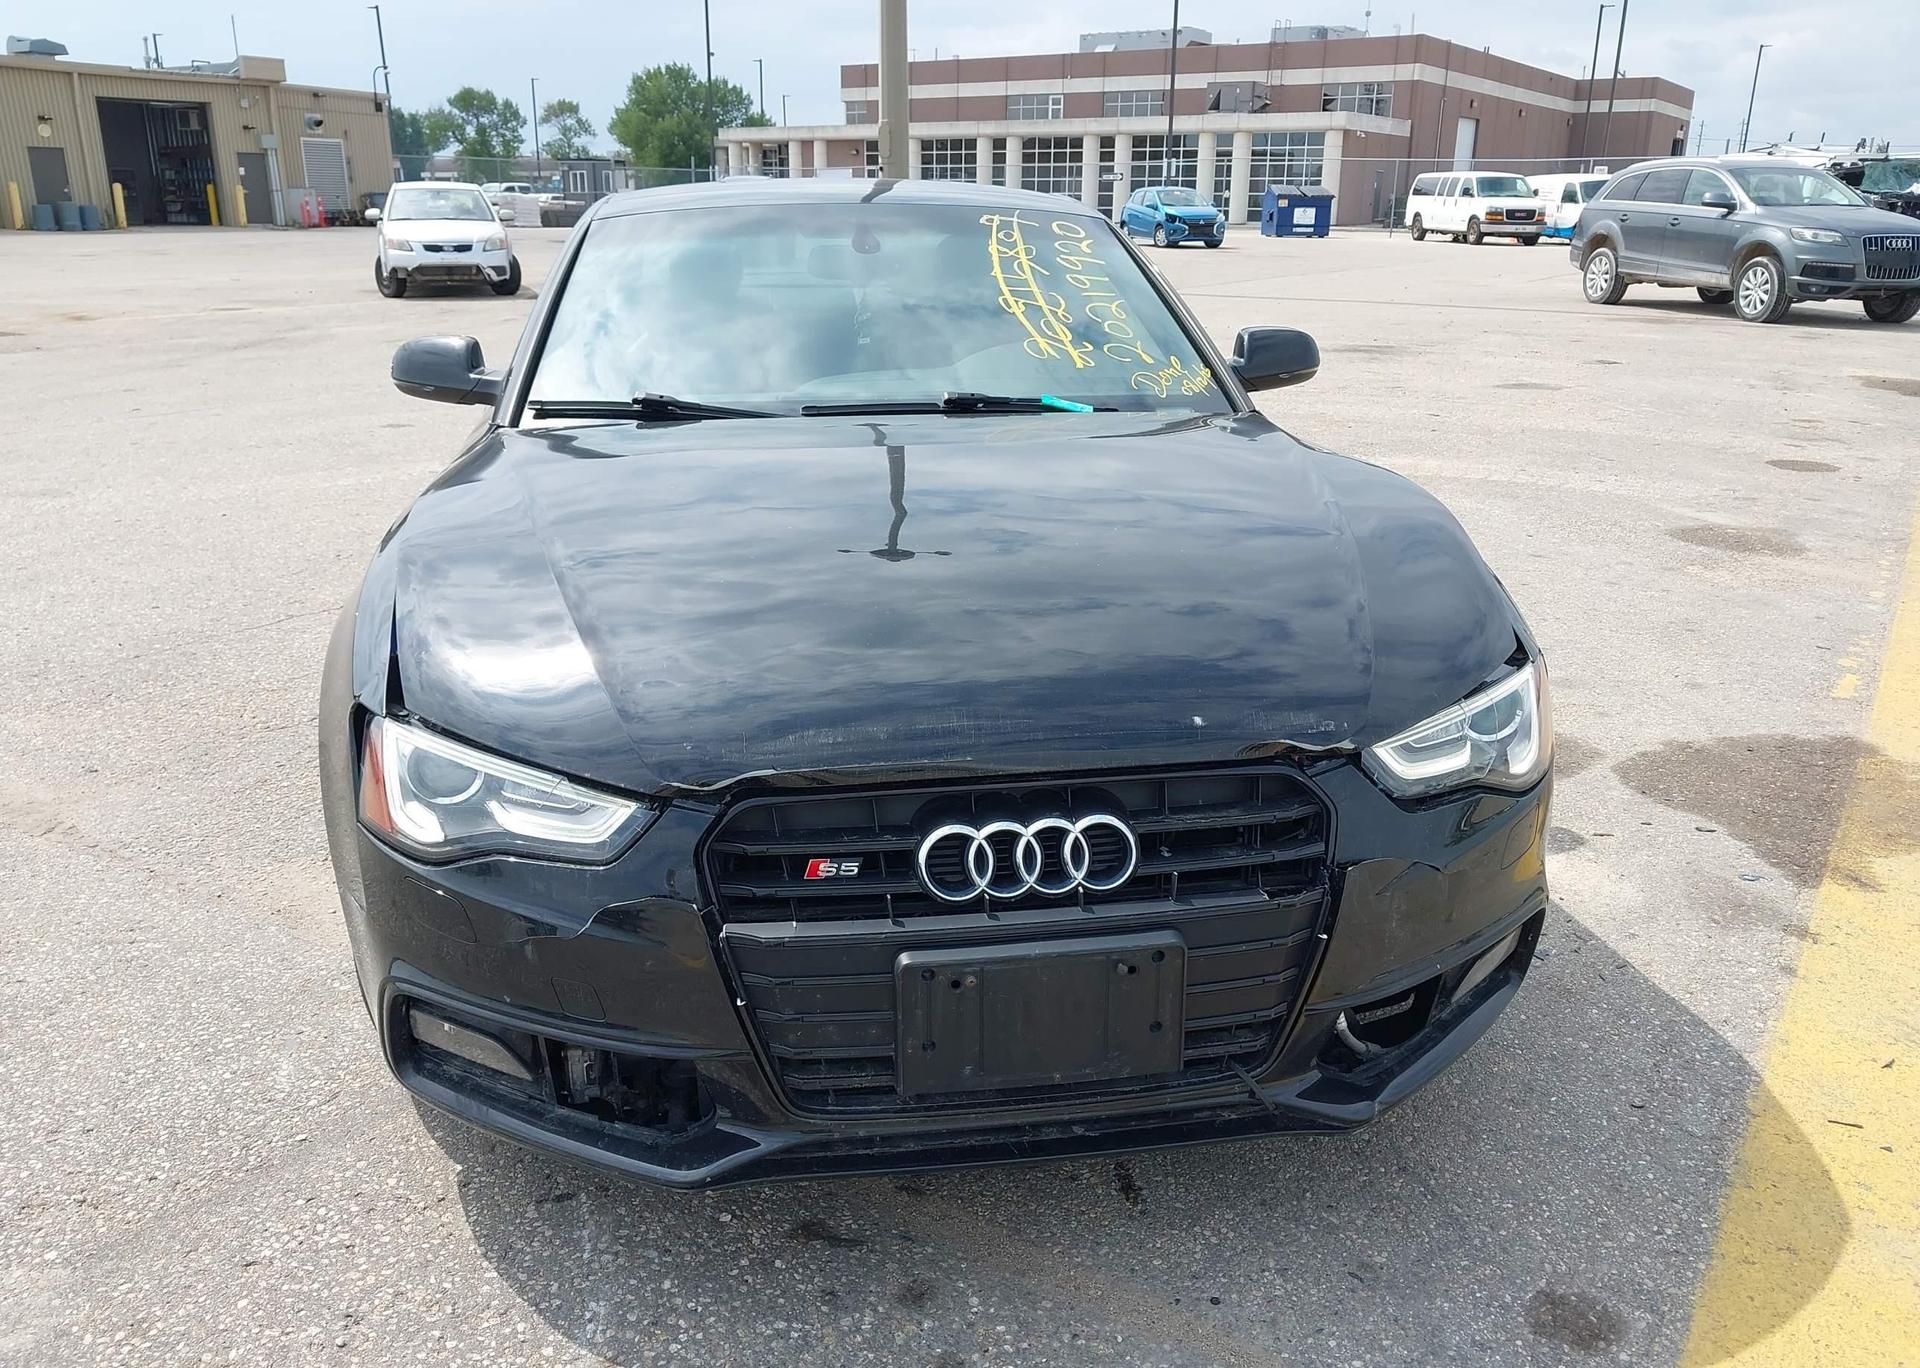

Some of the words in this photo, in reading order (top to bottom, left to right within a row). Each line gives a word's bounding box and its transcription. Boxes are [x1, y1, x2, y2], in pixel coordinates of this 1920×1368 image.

[1051, 221, 1154, 364] 20219920
[1131, 355, 1184, 398] Done
[816, 862, 860, 877] S5
